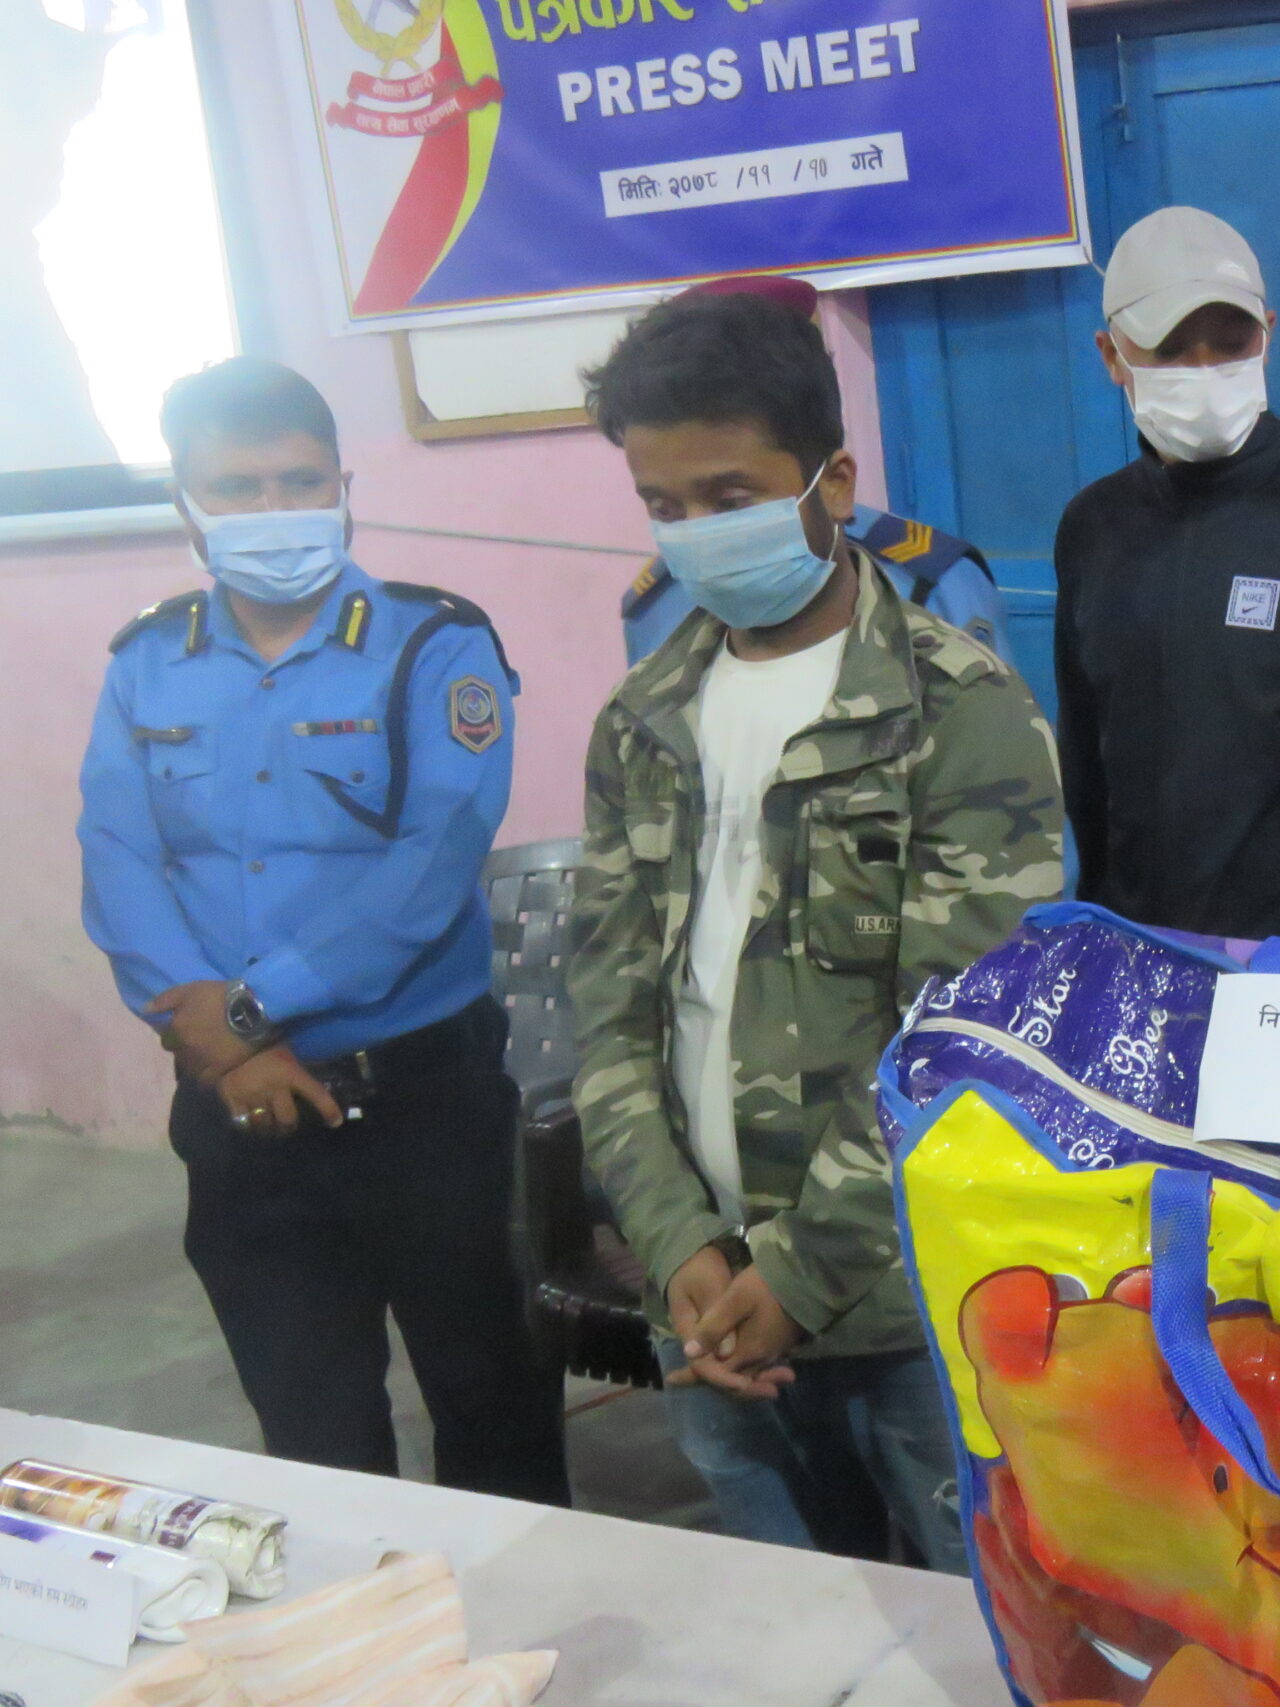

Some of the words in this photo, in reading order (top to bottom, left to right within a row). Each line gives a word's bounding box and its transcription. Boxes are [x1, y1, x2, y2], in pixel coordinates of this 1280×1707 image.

[557, 48, 743, 122] PRESS
[760, 18, 921, 94] MEET
[851, 144, 884, 172] गते
[1241, 591, 1266, 604] NIKE
[1008, 967, 1076, 1047] Star
[1109, 1009, 1168, 1079] Bee
